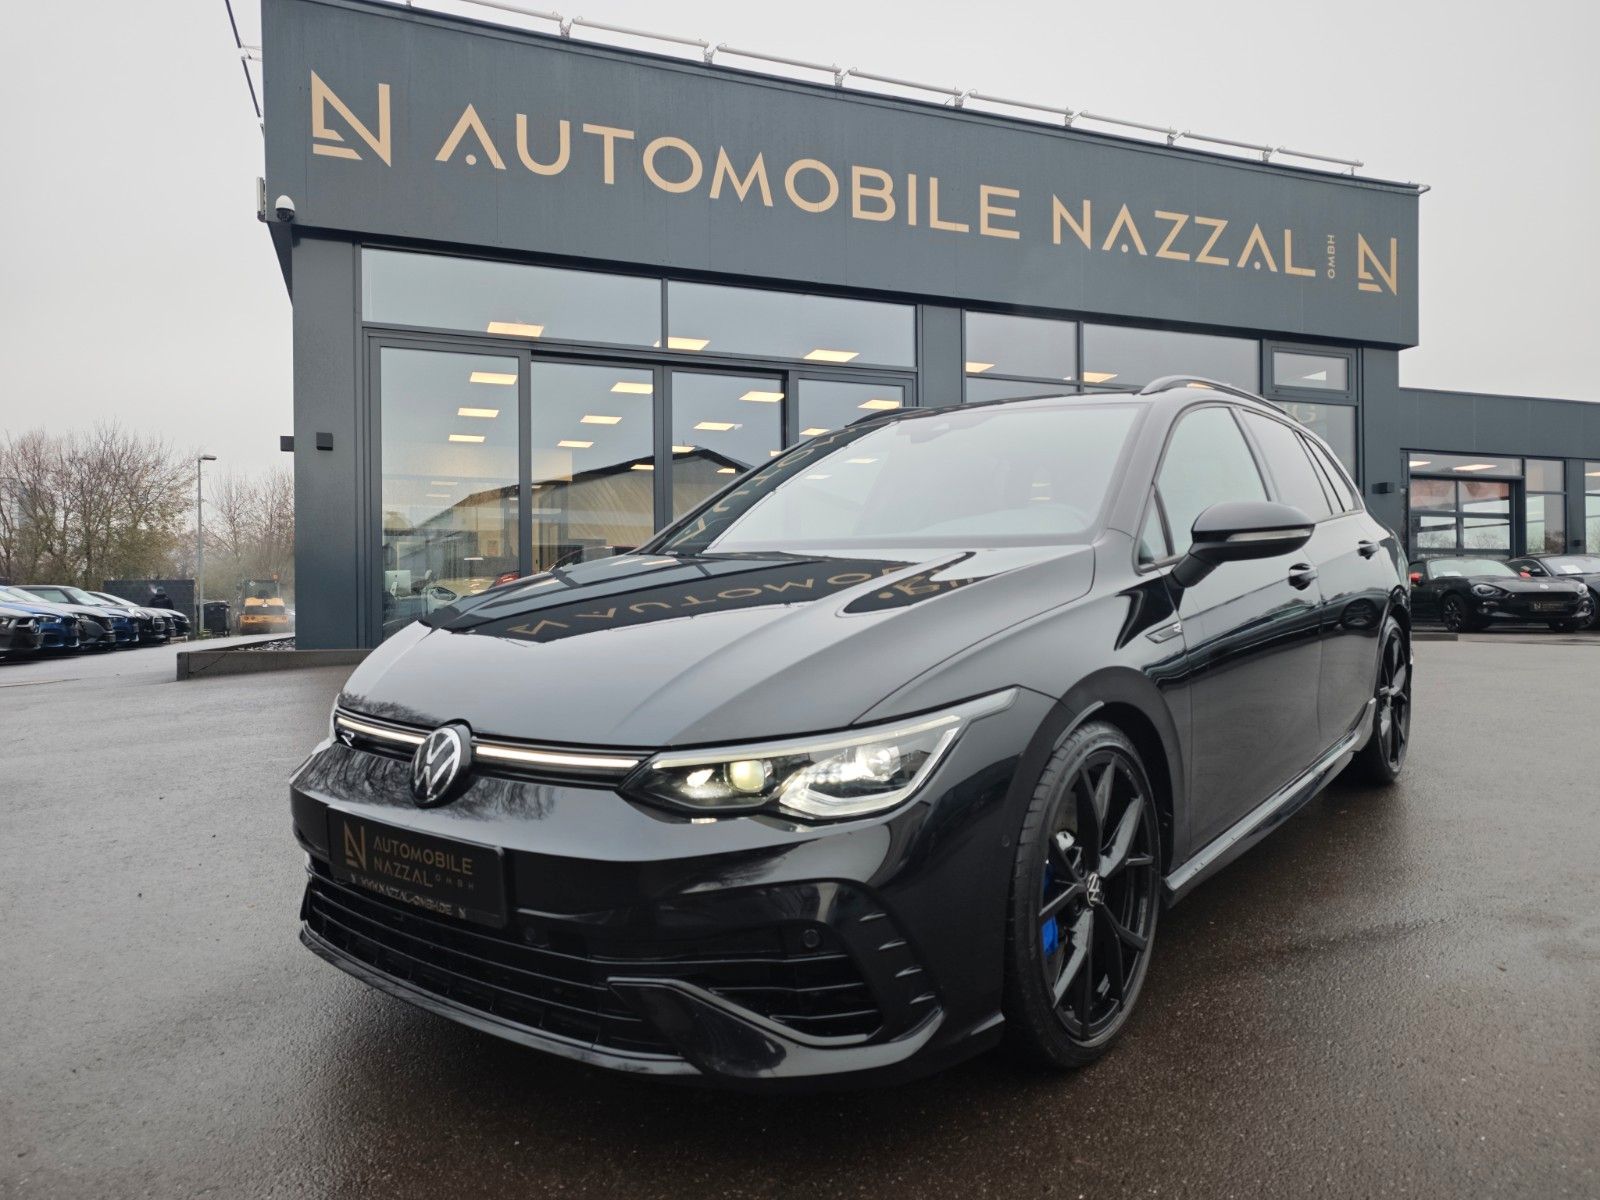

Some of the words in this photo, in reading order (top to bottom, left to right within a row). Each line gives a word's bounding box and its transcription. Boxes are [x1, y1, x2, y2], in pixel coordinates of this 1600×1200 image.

[435, 103, 1020, 240] AUTOMOBILE
[1051, 194, 1316, 278] NAZZAL
[373, 835, 473, 876] AUTOMOBILE
[374, 856, 434, 888] NAZZAL
